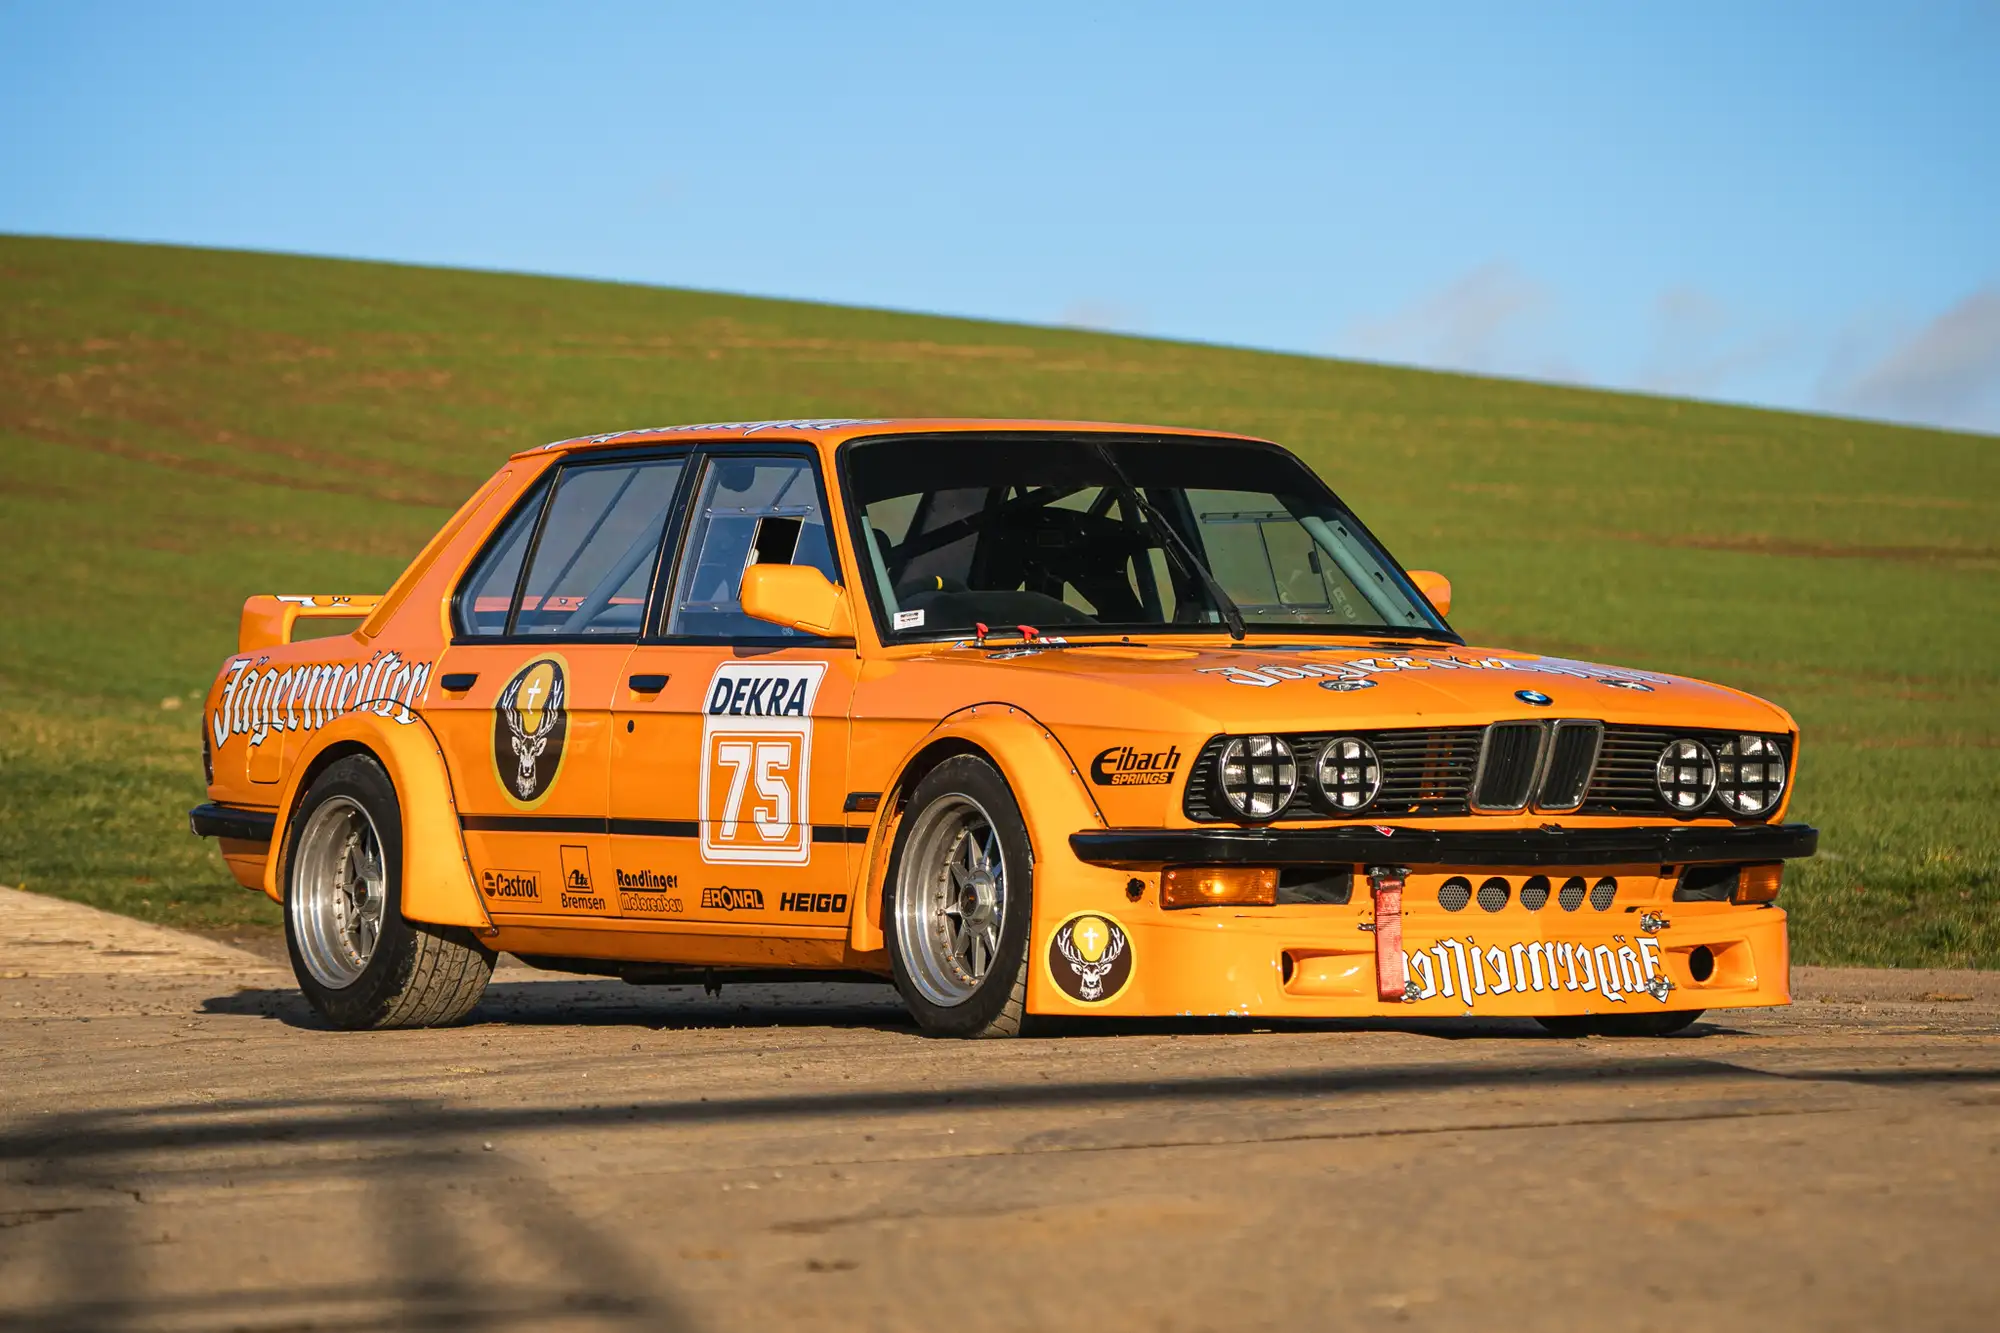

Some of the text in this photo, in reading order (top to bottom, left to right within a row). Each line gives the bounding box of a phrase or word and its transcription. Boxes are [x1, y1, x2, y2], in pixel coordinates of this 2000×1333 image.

[709, 677, 808, 716] DEKRA
[1091, 745, 1181, 781] Eibach
[1111, 773, 1170, 785] SPRINGS
[718, 742, 792, 842] 75
[496, 873, 539, 898] Castrol
[616, 868, 678, 890] Randlinger
[561, 892, 606, 910] Bremsen
[620, 892, 684, 913] Motorenbau
[710, 886, 764, 911] RONAL
[779, 892, 848, 913] HEIGO
